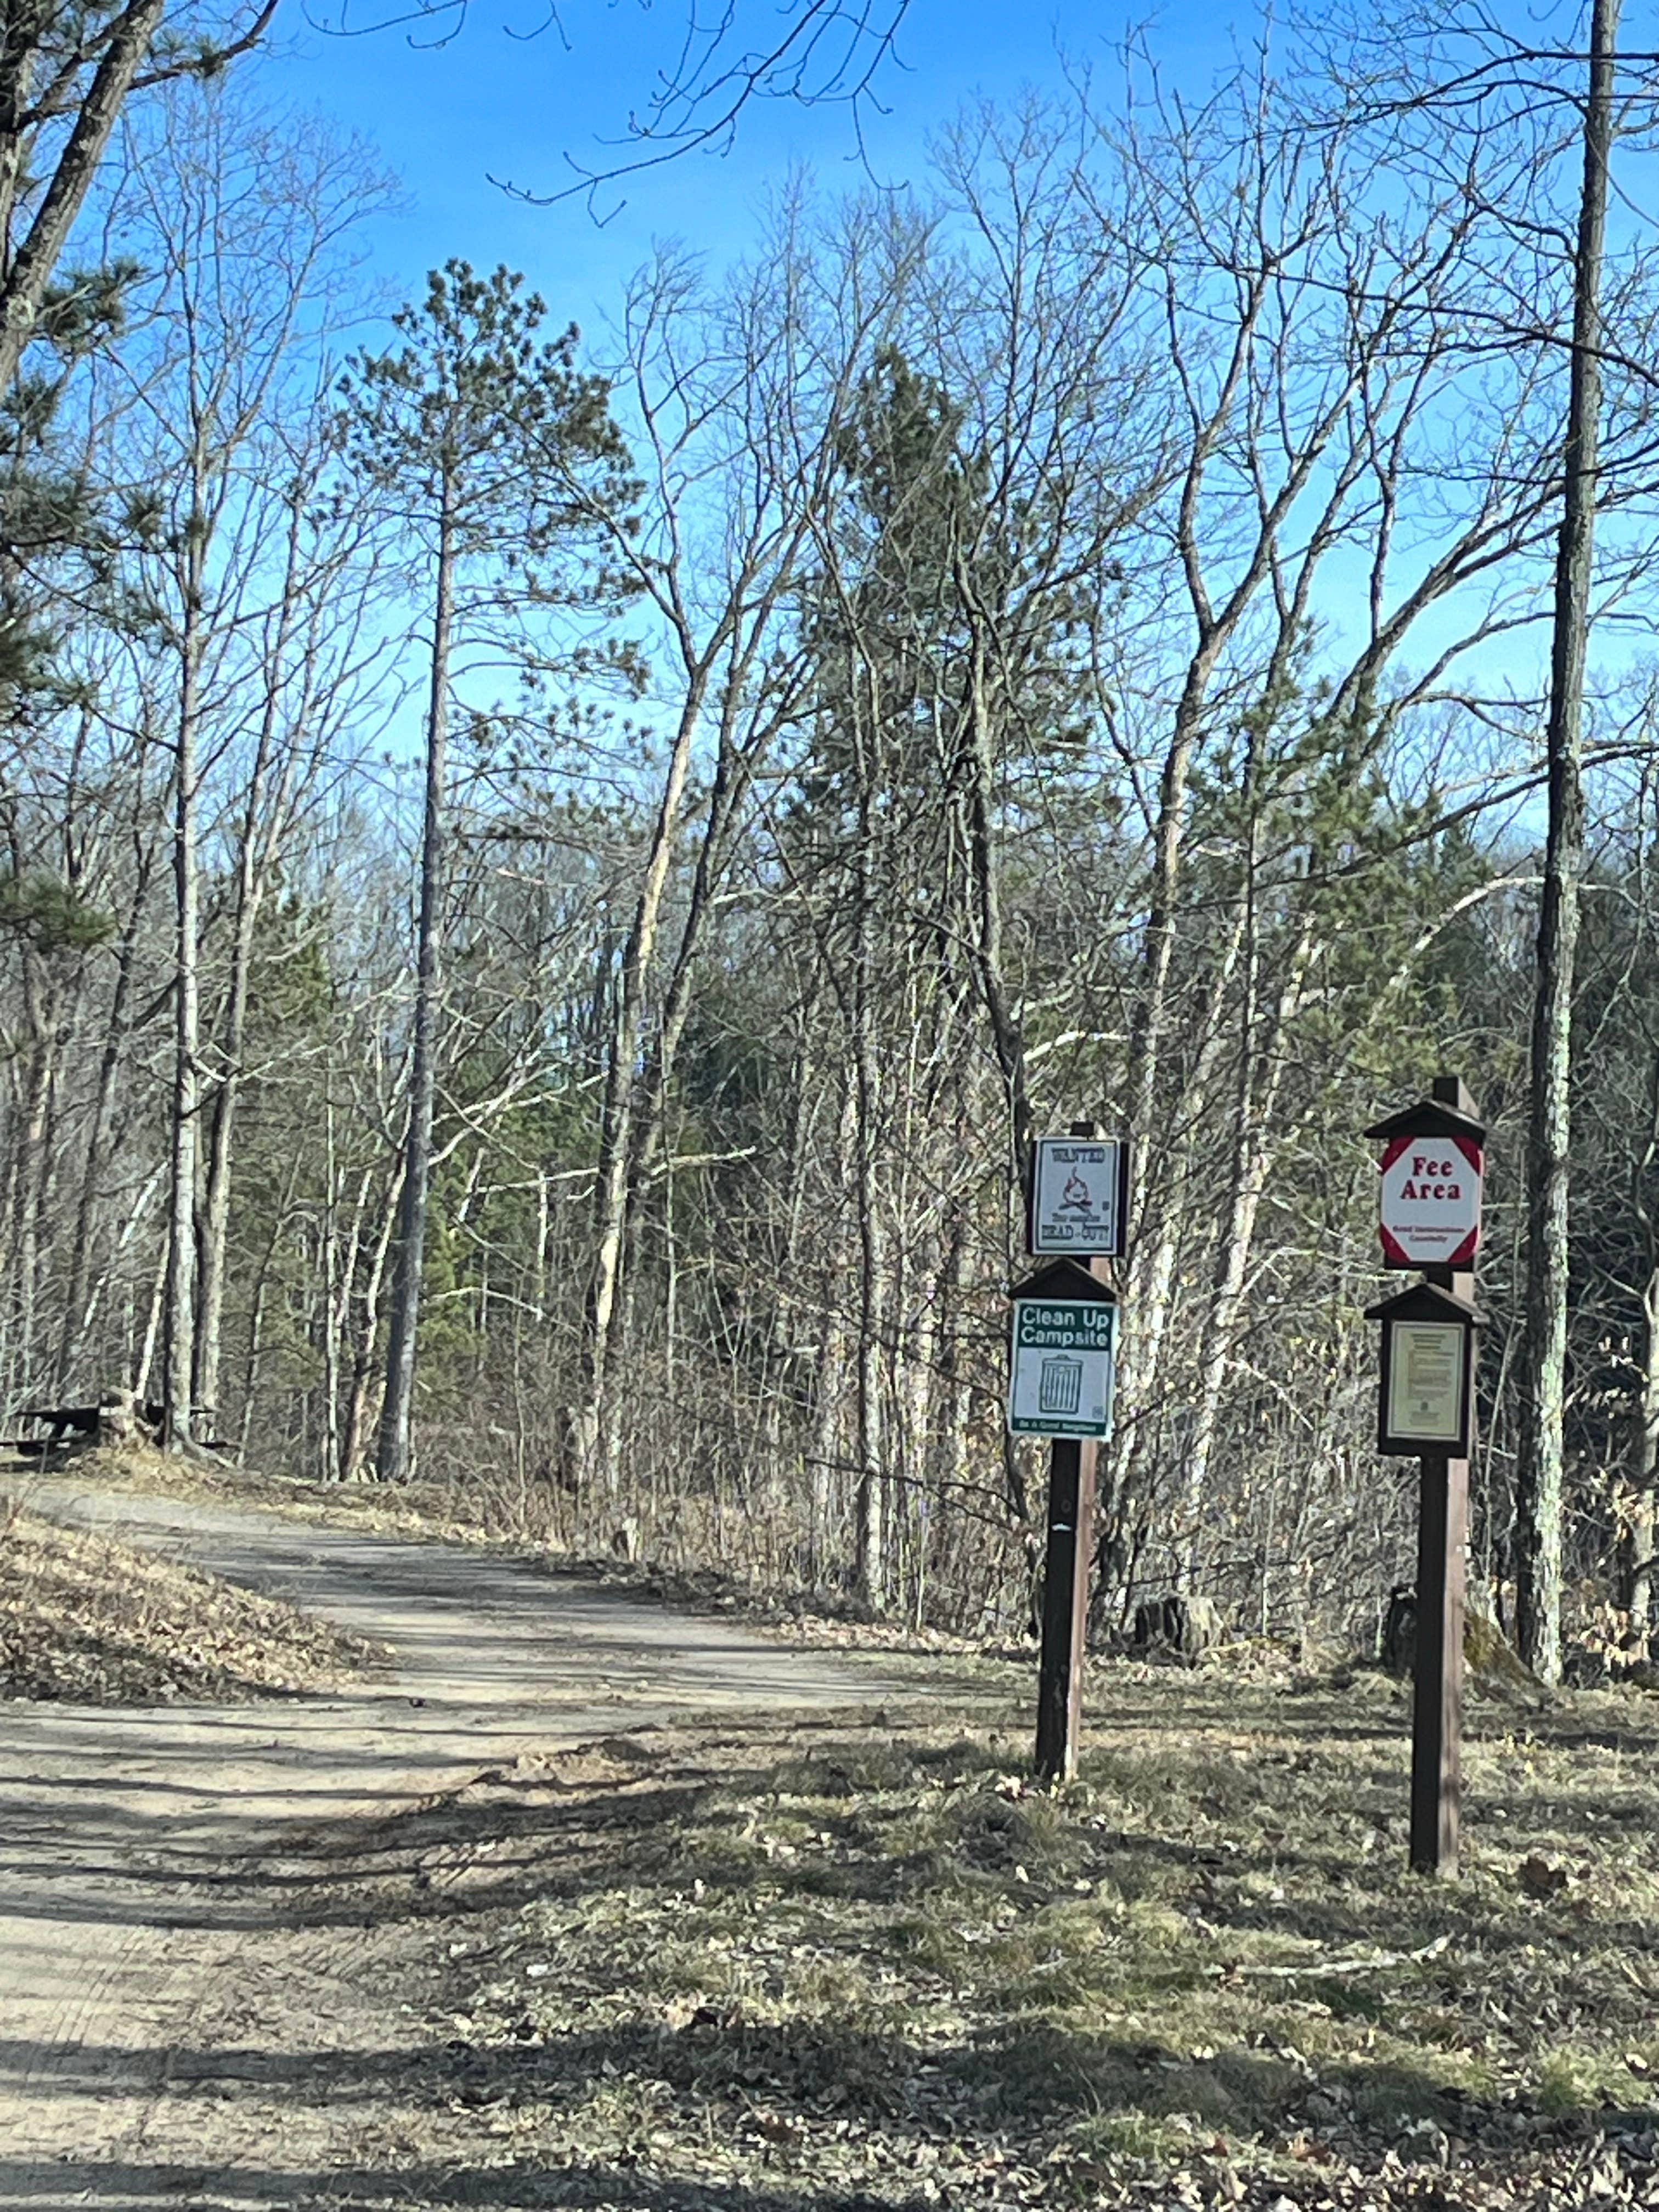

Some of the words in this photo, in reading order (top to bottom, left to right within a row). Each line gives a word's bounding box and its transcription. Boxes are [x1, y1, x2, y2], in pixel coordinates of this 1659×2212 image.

[1412, 1156, 1453, 1177] Fee
[1400, 1180, 1460, 1200] Area
[1022, 1306, 1075, 1326] Clean
[1082, 1309, 1109, 1330] Up
[1021, 1326, 1109, 1347] Campsite
